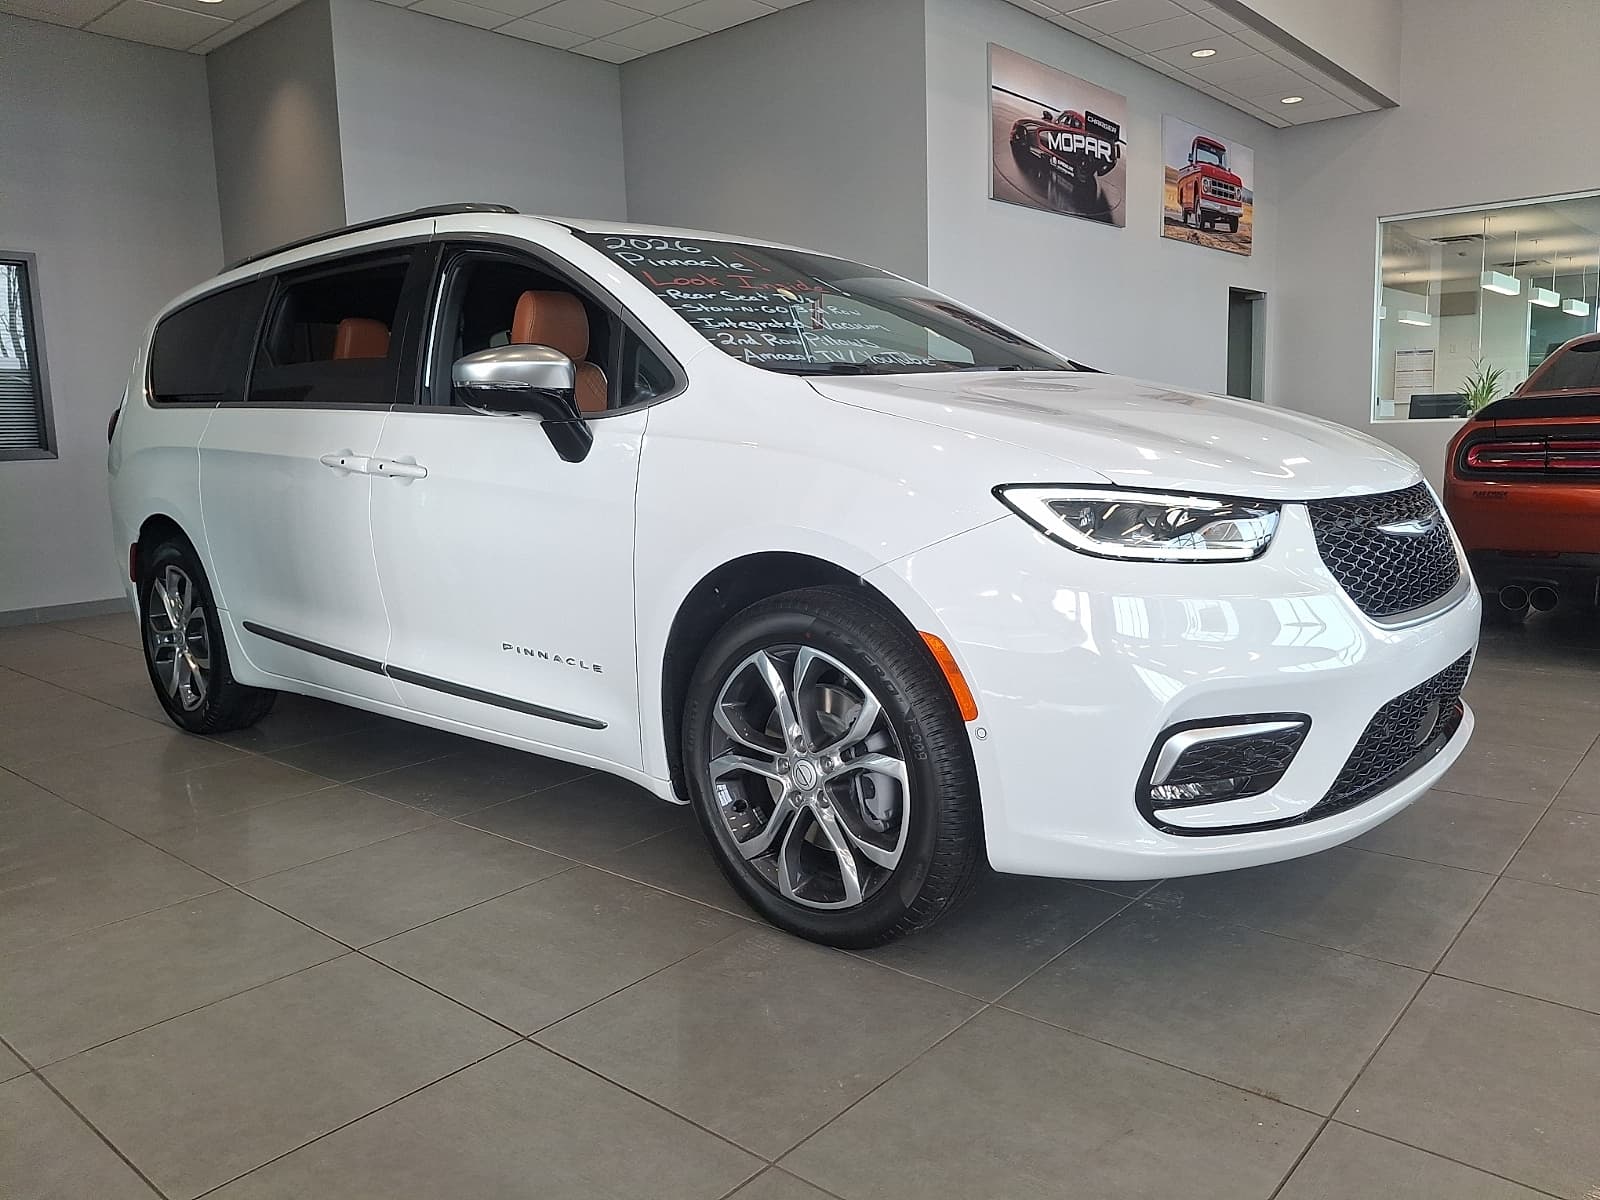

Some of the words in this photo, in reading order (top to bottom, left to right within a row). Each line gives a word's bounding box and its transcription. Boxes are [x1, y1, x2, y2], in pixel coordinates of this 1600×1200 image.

[1048, 132, 1112, 163] MOPAR
[604, 237, 701, 253] 2026
[642, 271, 724, 286] Look
[719, 290, 769, 302] Seat
[811, 316, 891, 332] Vacuum
[760, 333, 802, 347] Row
[802, 332, 880, 348] Pillows
[502, 642, 604, 674] PINNACLE
